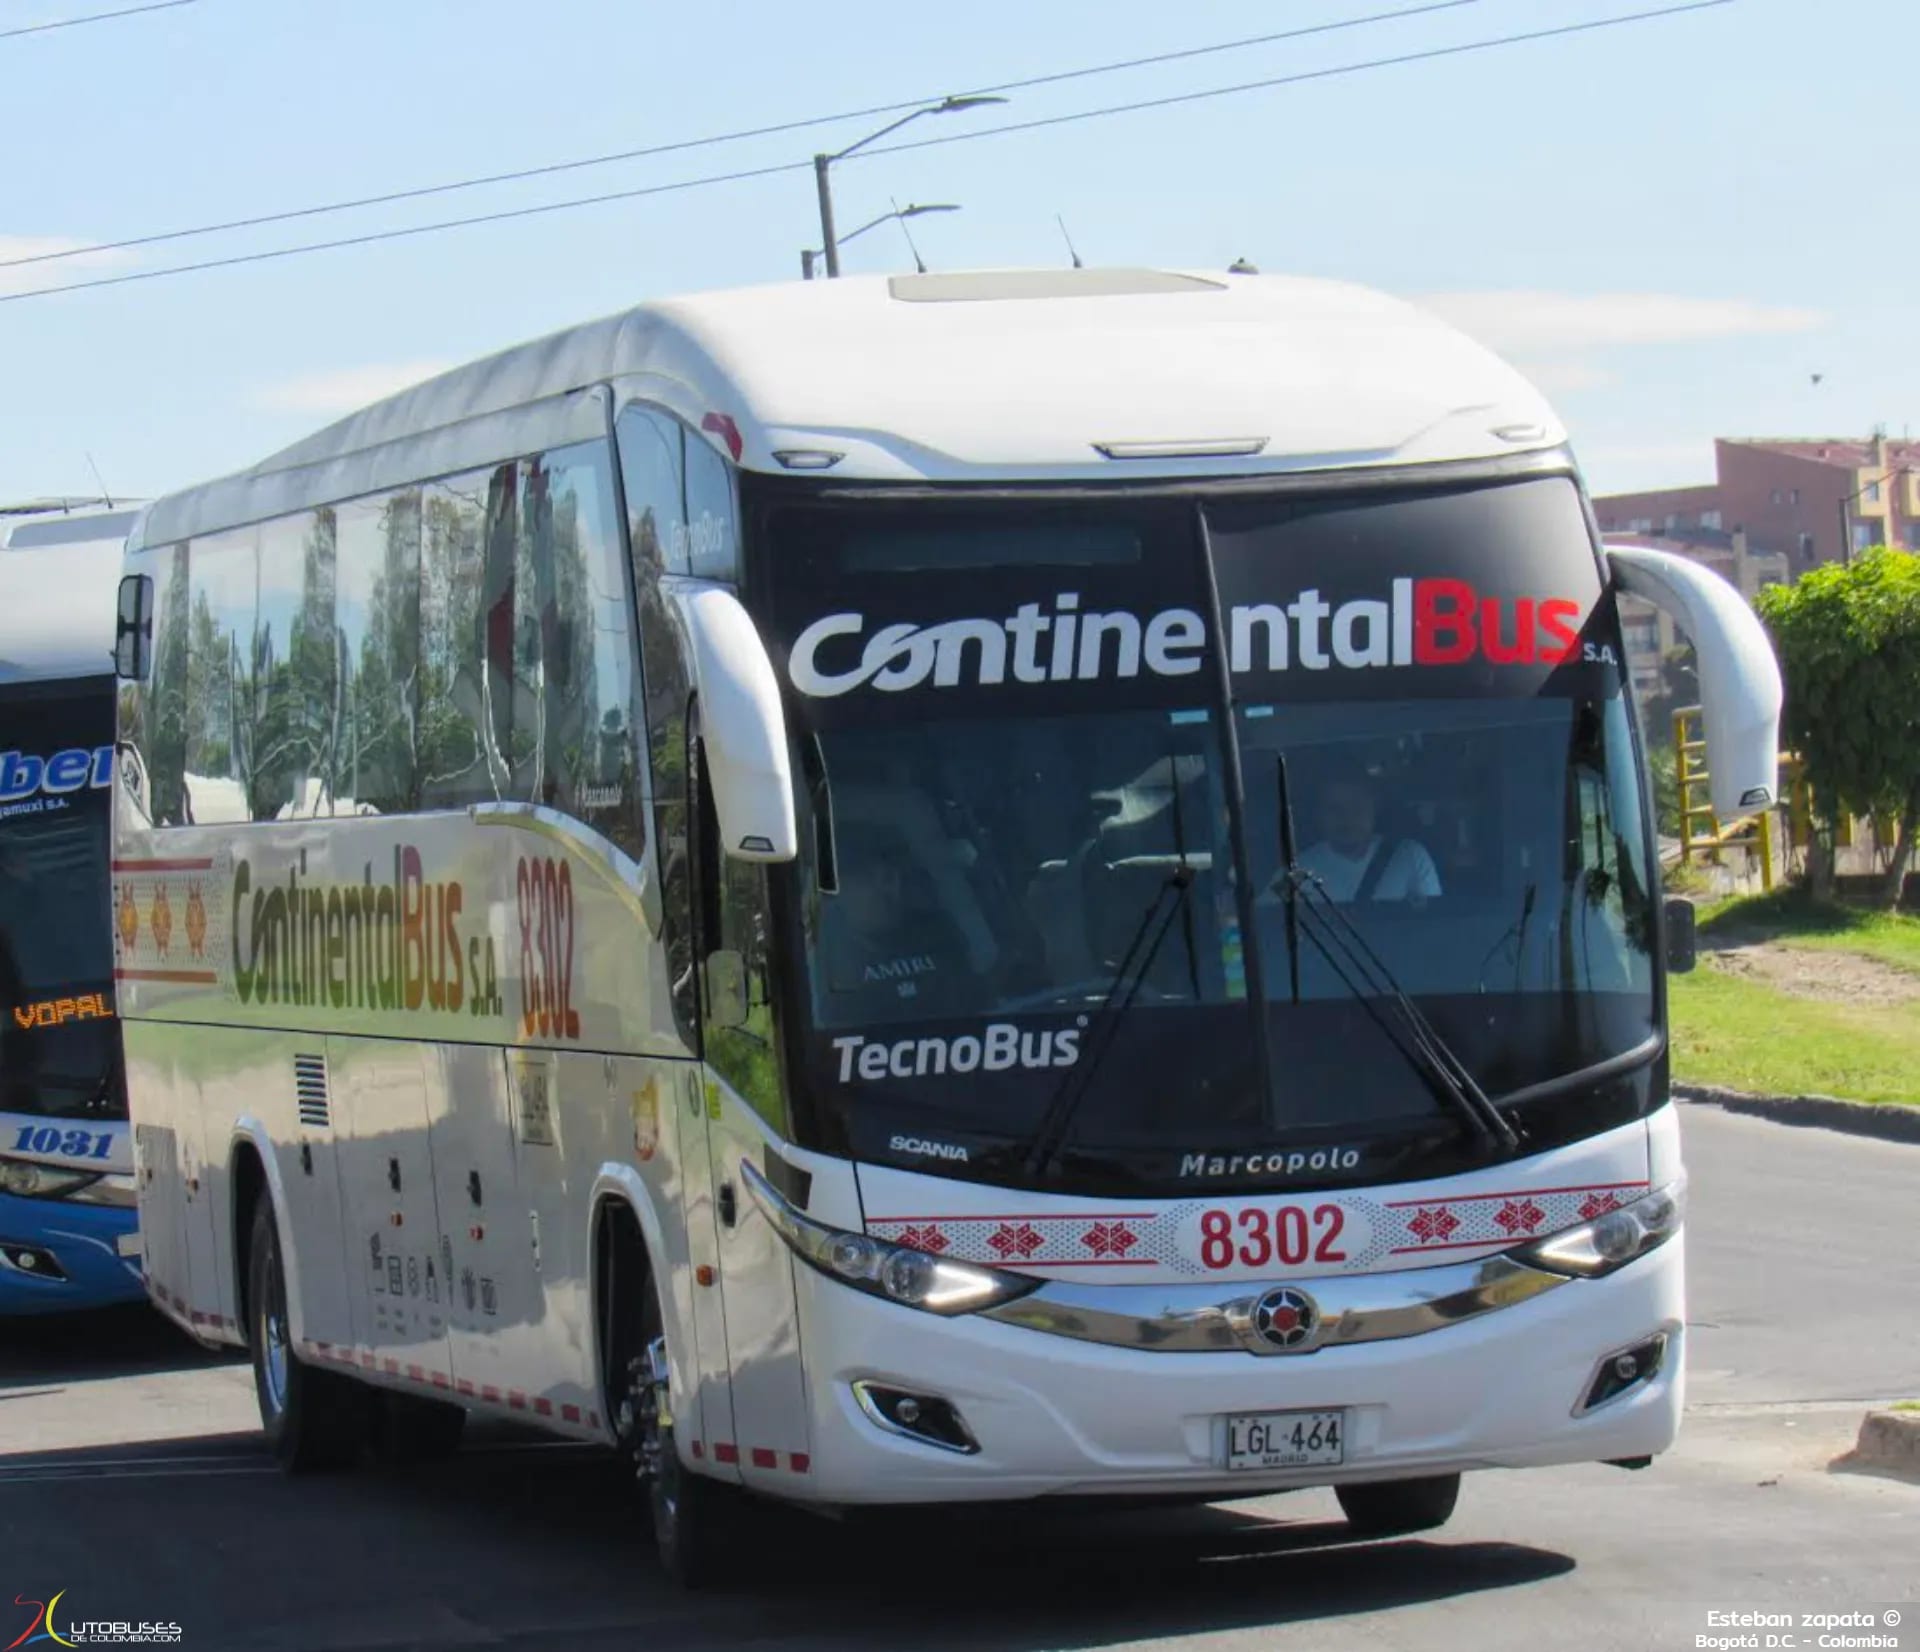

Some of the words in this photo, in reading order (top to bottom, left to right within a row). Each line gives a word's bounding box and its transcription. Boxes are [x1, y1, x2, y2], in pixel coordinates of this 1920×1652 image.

[1583, 641, 1618, 666] S.A.
[232, 845, 464, 1014] ContinentalBus
[516, 855, 580, 1040] 8302
[9, 1125, 114, 1159] 1031
[888, 1135, 969, 1163] SCANIA
[1179, 1147, 1360, 1178] Marcopolo
[1200, 1203, 1347, 1270] 8302
